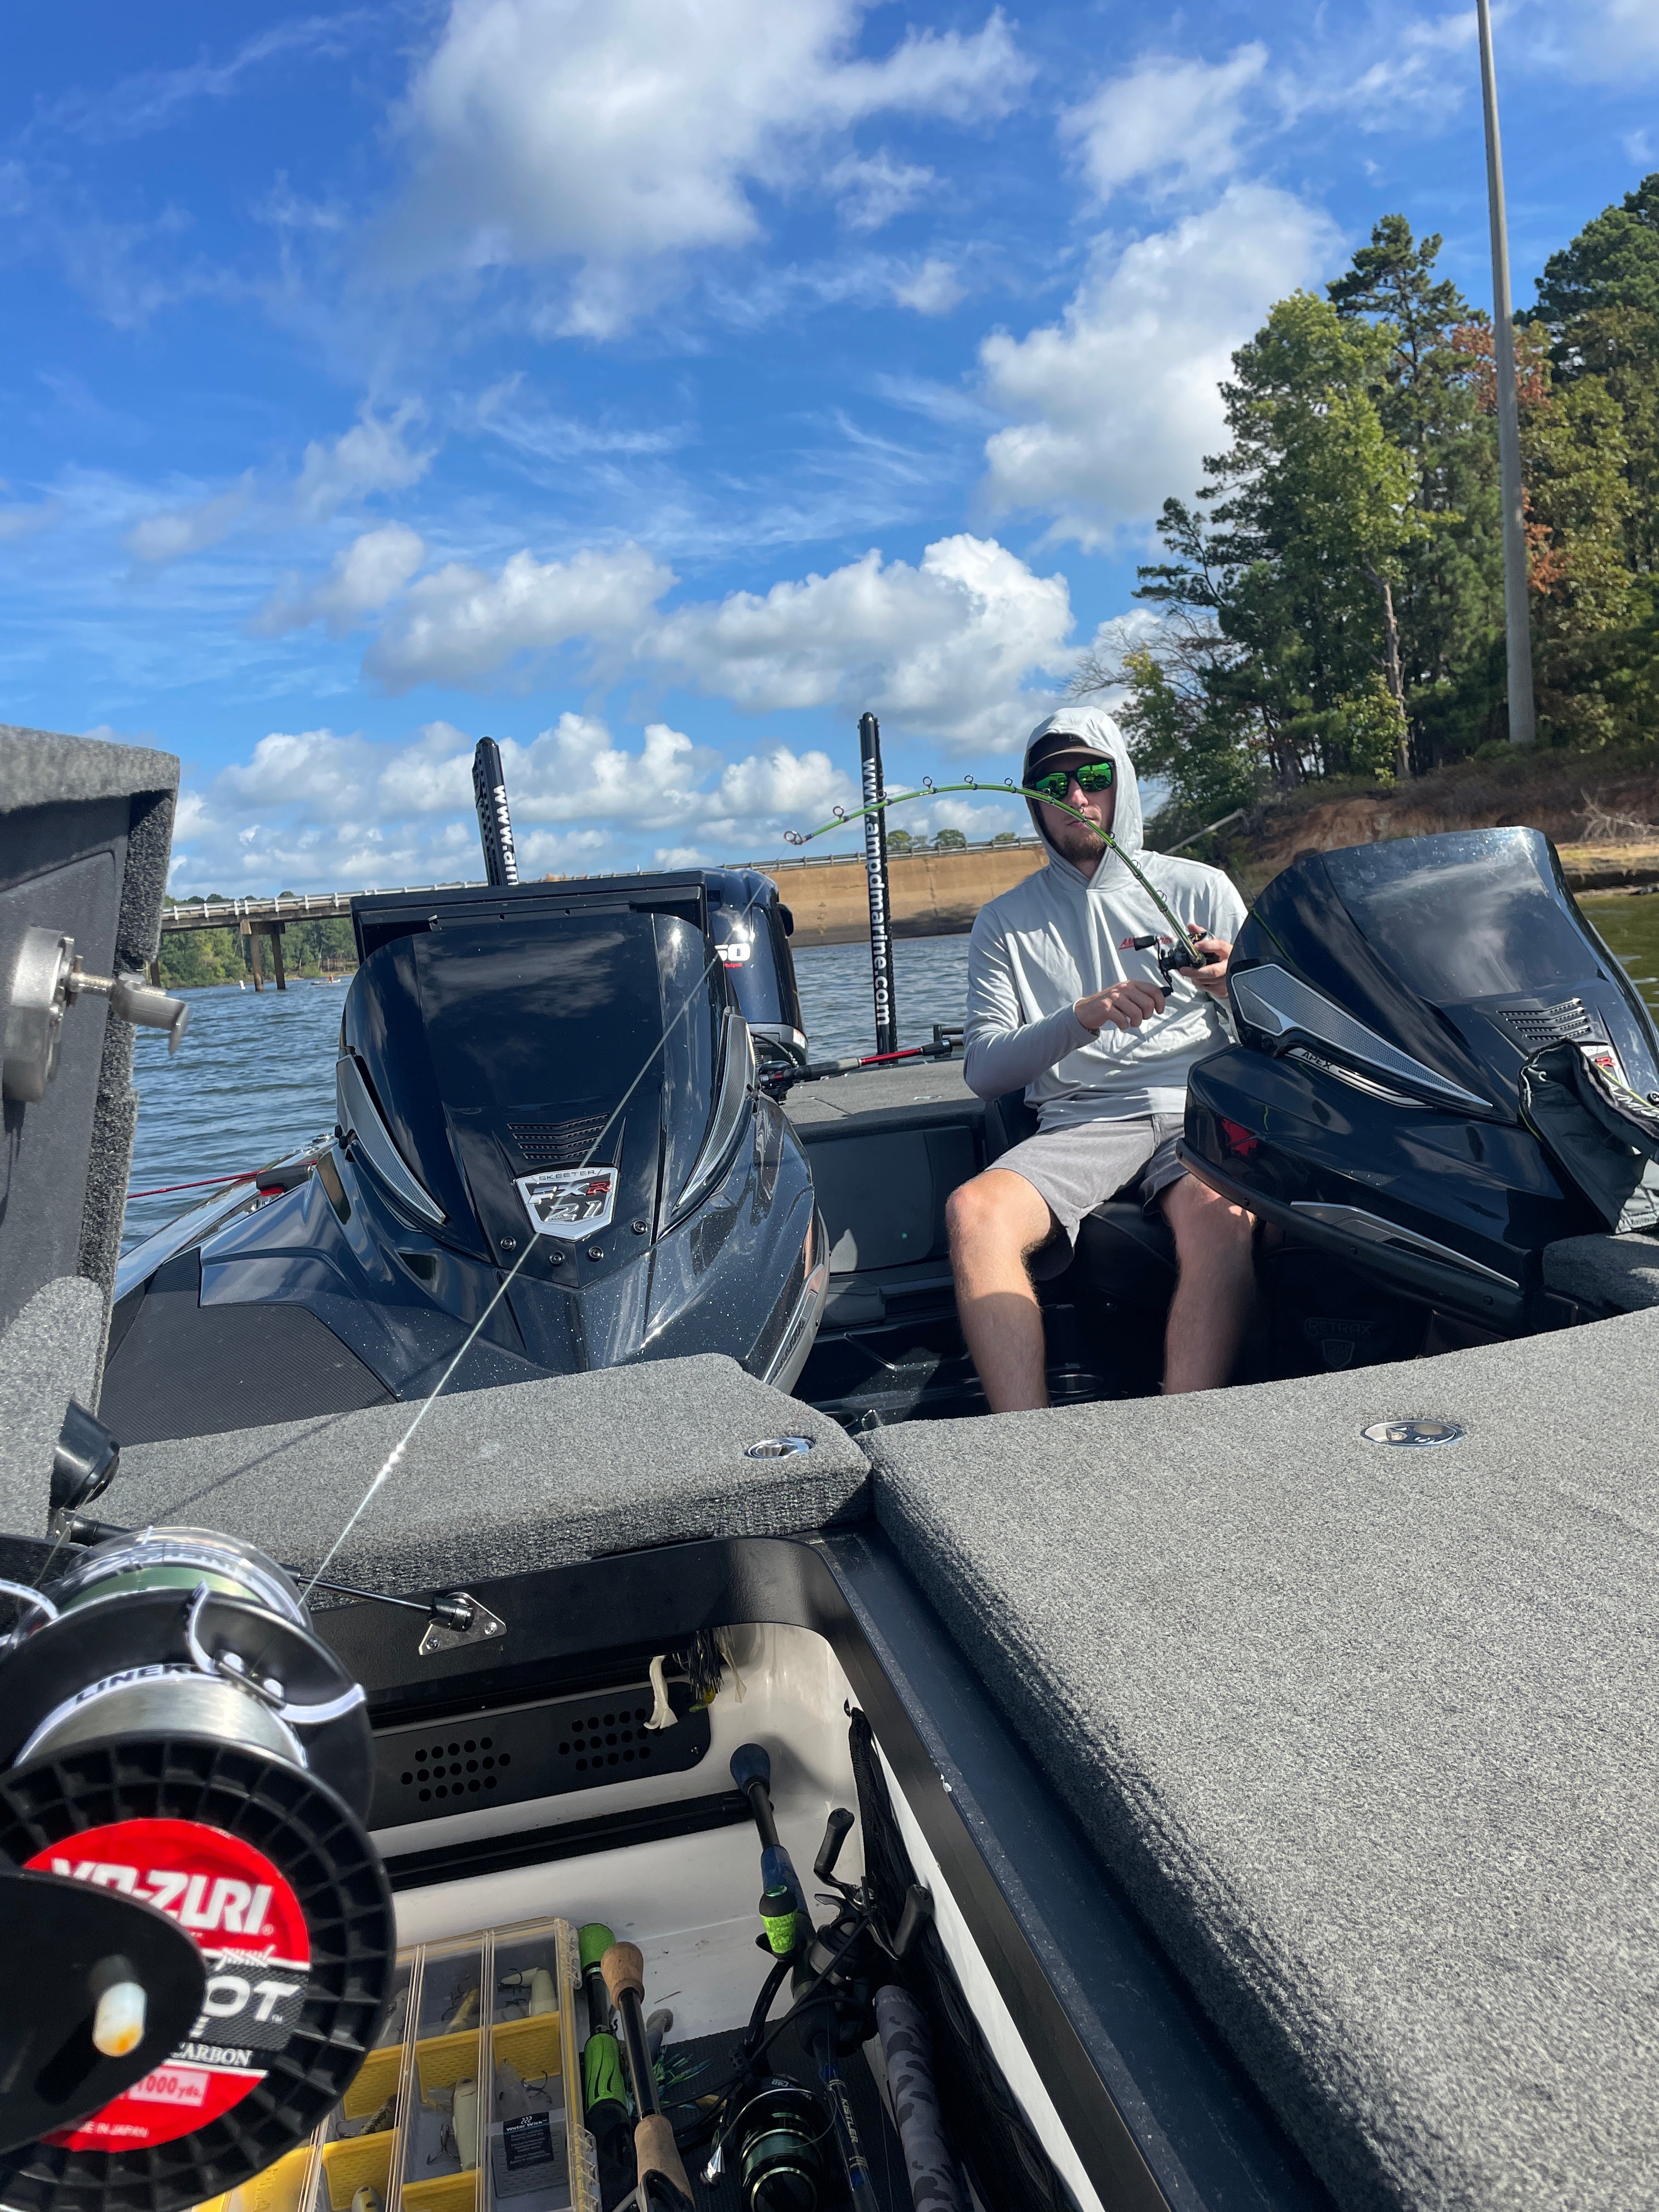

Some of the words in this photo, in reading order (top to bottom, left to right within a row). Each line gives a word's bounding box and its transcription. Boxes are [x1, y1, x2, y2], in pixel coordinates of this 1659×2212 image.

[862, 757, 889, 1025] www.ampdmarine.com
[1301, 1052, 1333, 1070] APEX
[539, 1170, 595, 1181] SKEETER
[528, 1181, 612, 1205] FXR
[544, 1200, 602, 1222] 21
[112, 2124, 148, 2138] JAPAN
[841, 2098, 859, 2143] KISTLER
